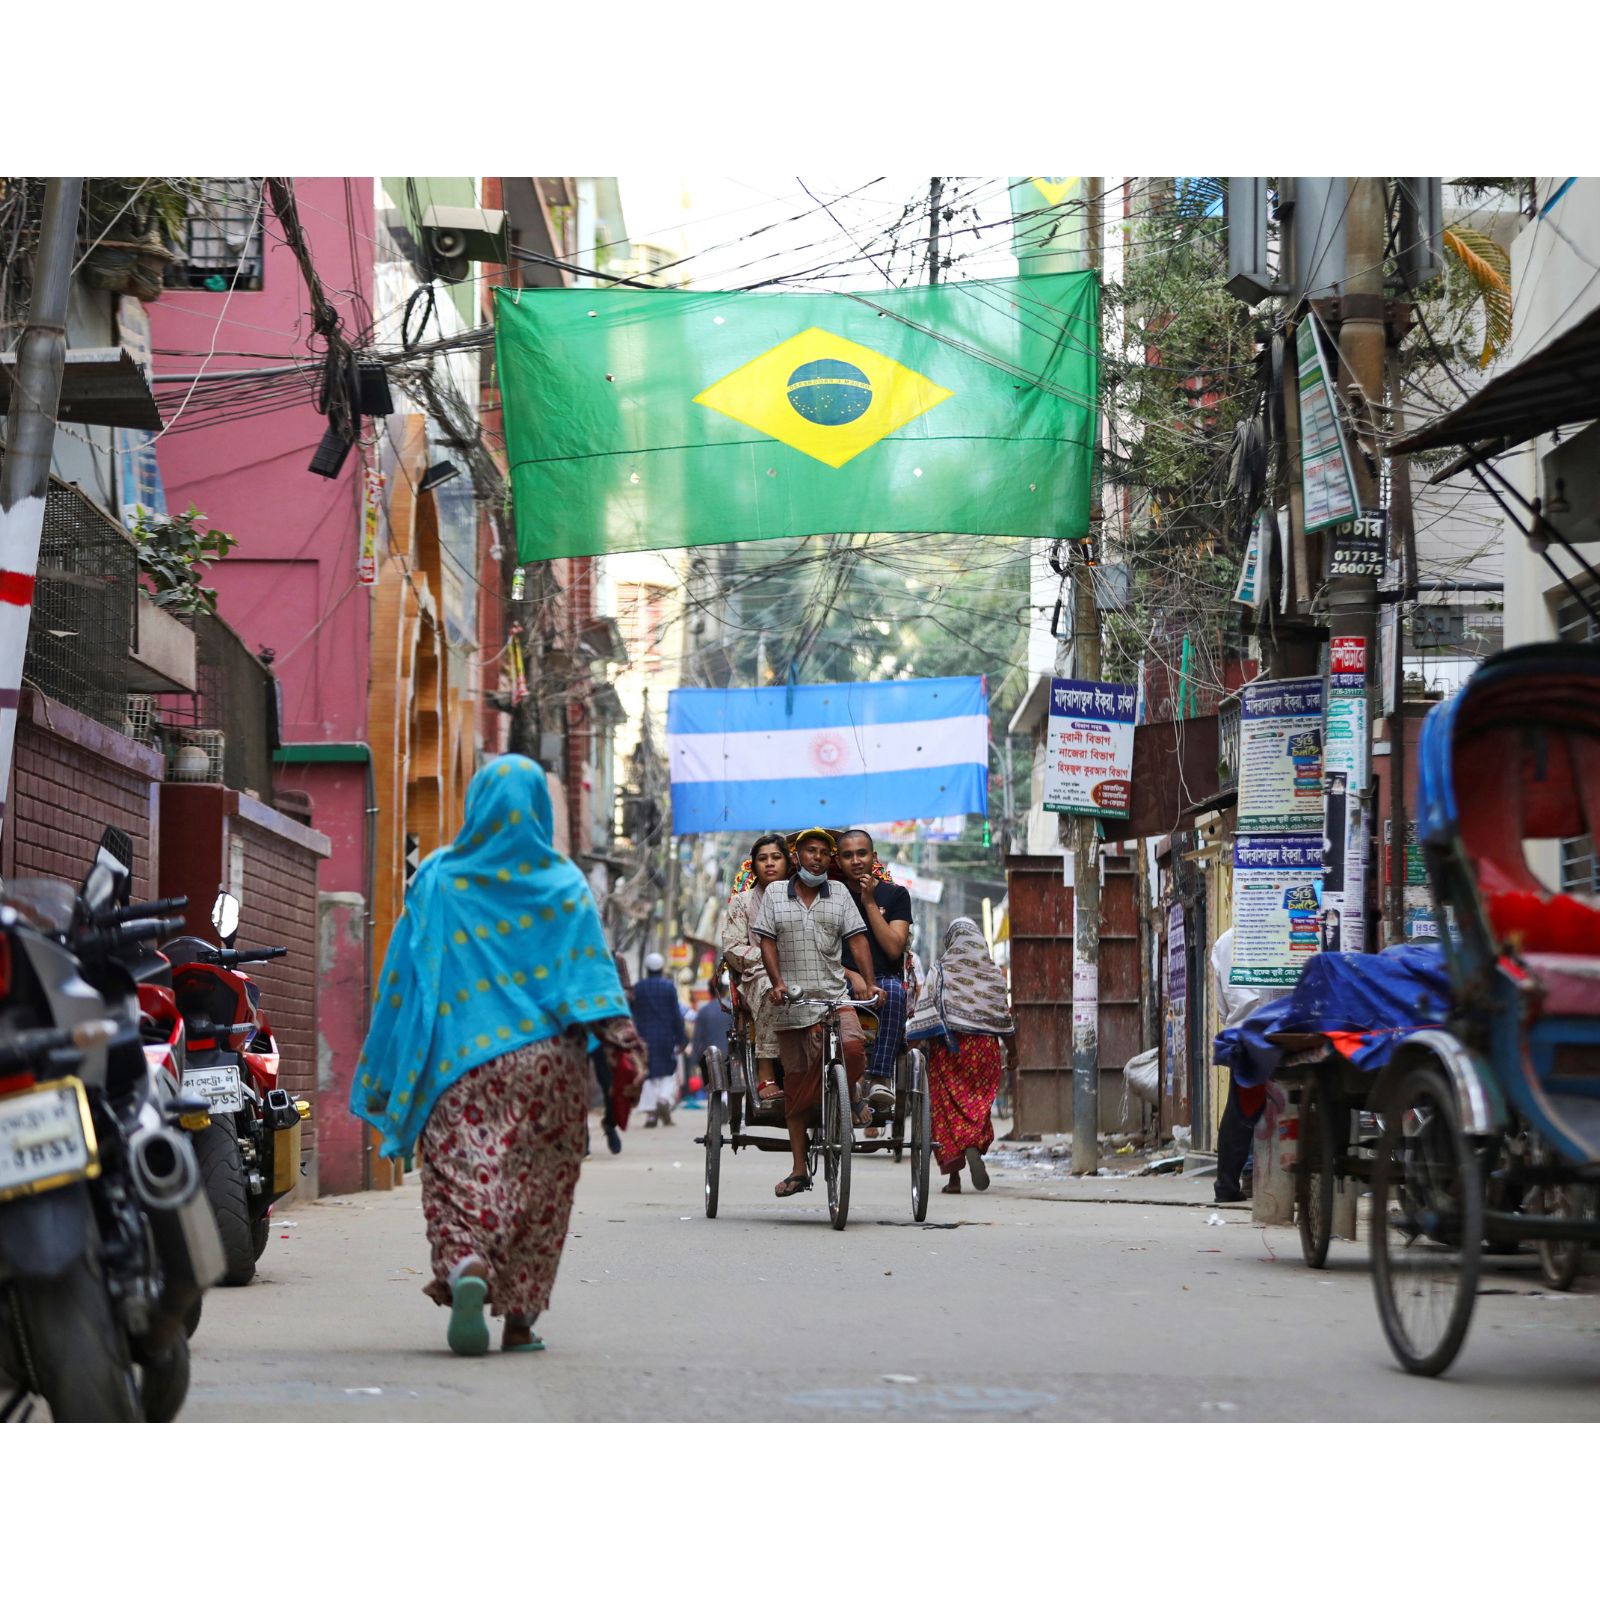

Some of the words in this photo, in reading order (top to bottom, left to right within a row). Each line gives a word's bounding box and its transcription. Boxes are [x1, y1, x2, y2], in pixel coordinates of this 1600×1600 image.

[1334, 550, 1384, 562] 01713-
[1330, 562, 1383, 575] 260075
[1117, 692, 1134, 714] ঢাকা
[1086, 732, 1111, 746] বিভাগ
[1091, 748, 1115, 762] বিভাগ
[1109, 764, 1128, 778] বিভাগ
[184, 1079, 194, 1087] কা
